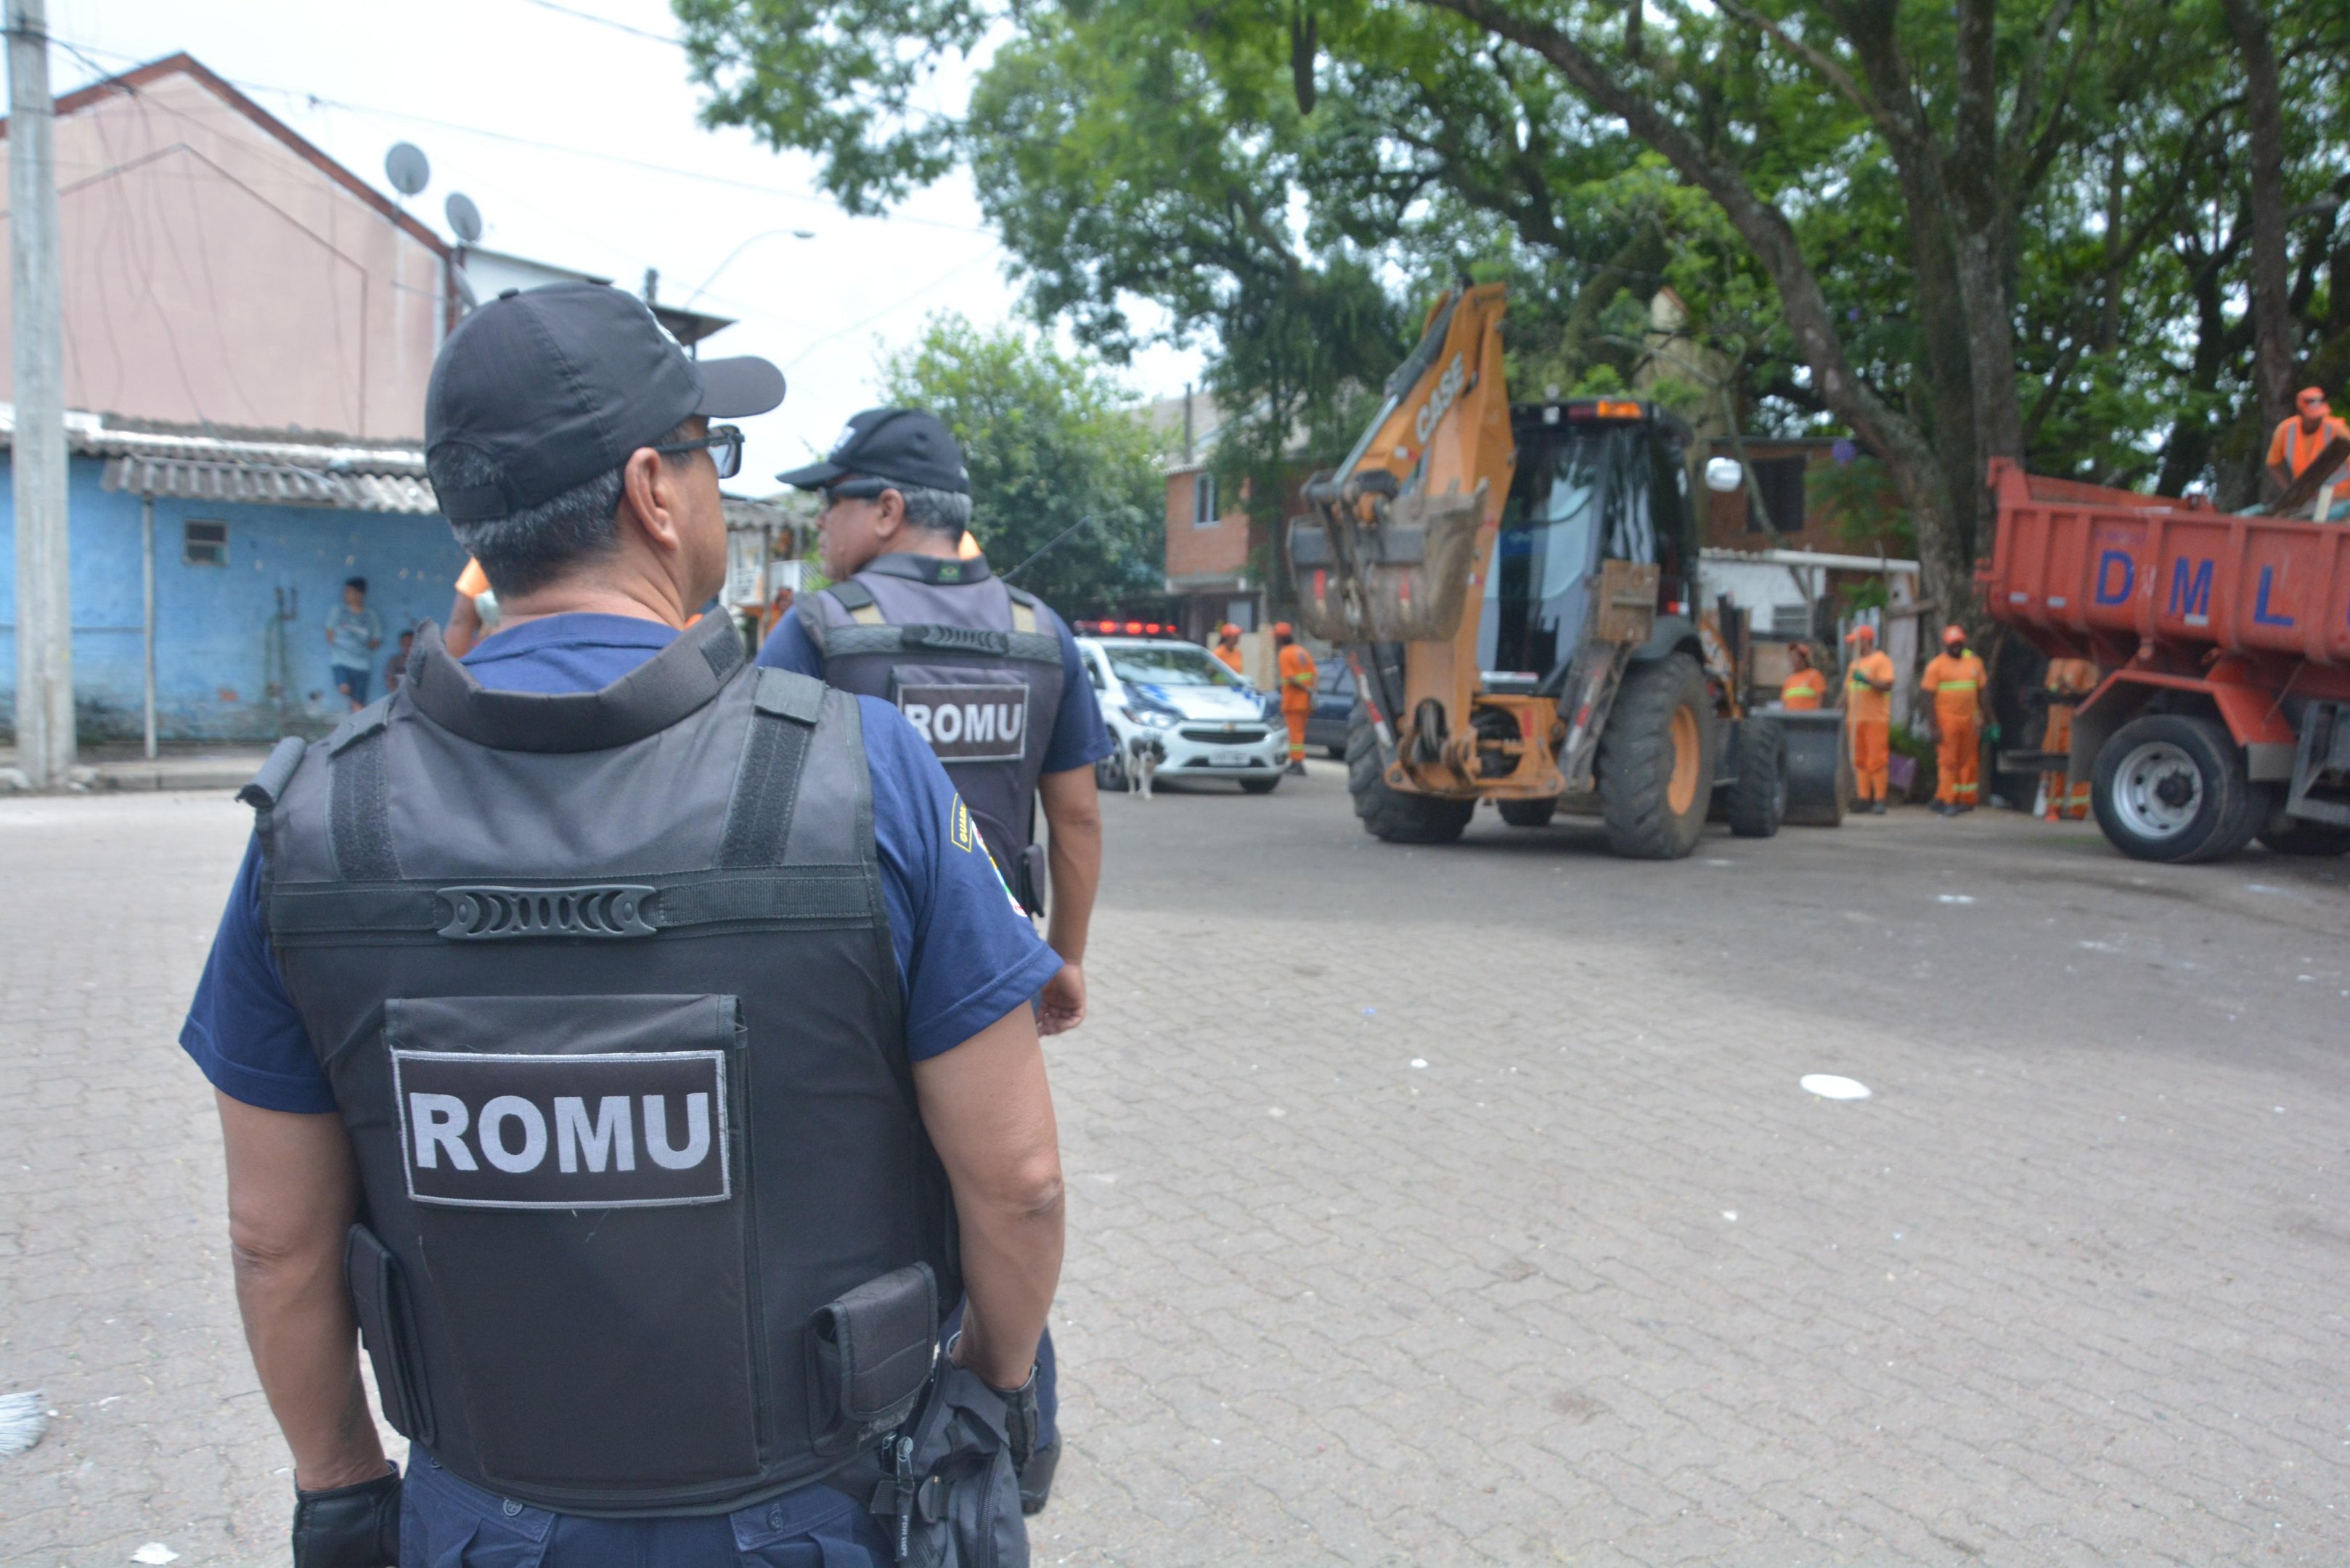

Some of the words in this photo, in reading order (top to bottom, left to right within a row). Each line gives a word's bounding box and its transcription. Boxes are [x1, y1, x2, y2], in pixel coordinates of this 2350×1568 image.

[1416, 349, 1465, 445] CASE
[904, 703, 1024, 744] ROMU
[408, 1091, 711, 1174] ROMU
